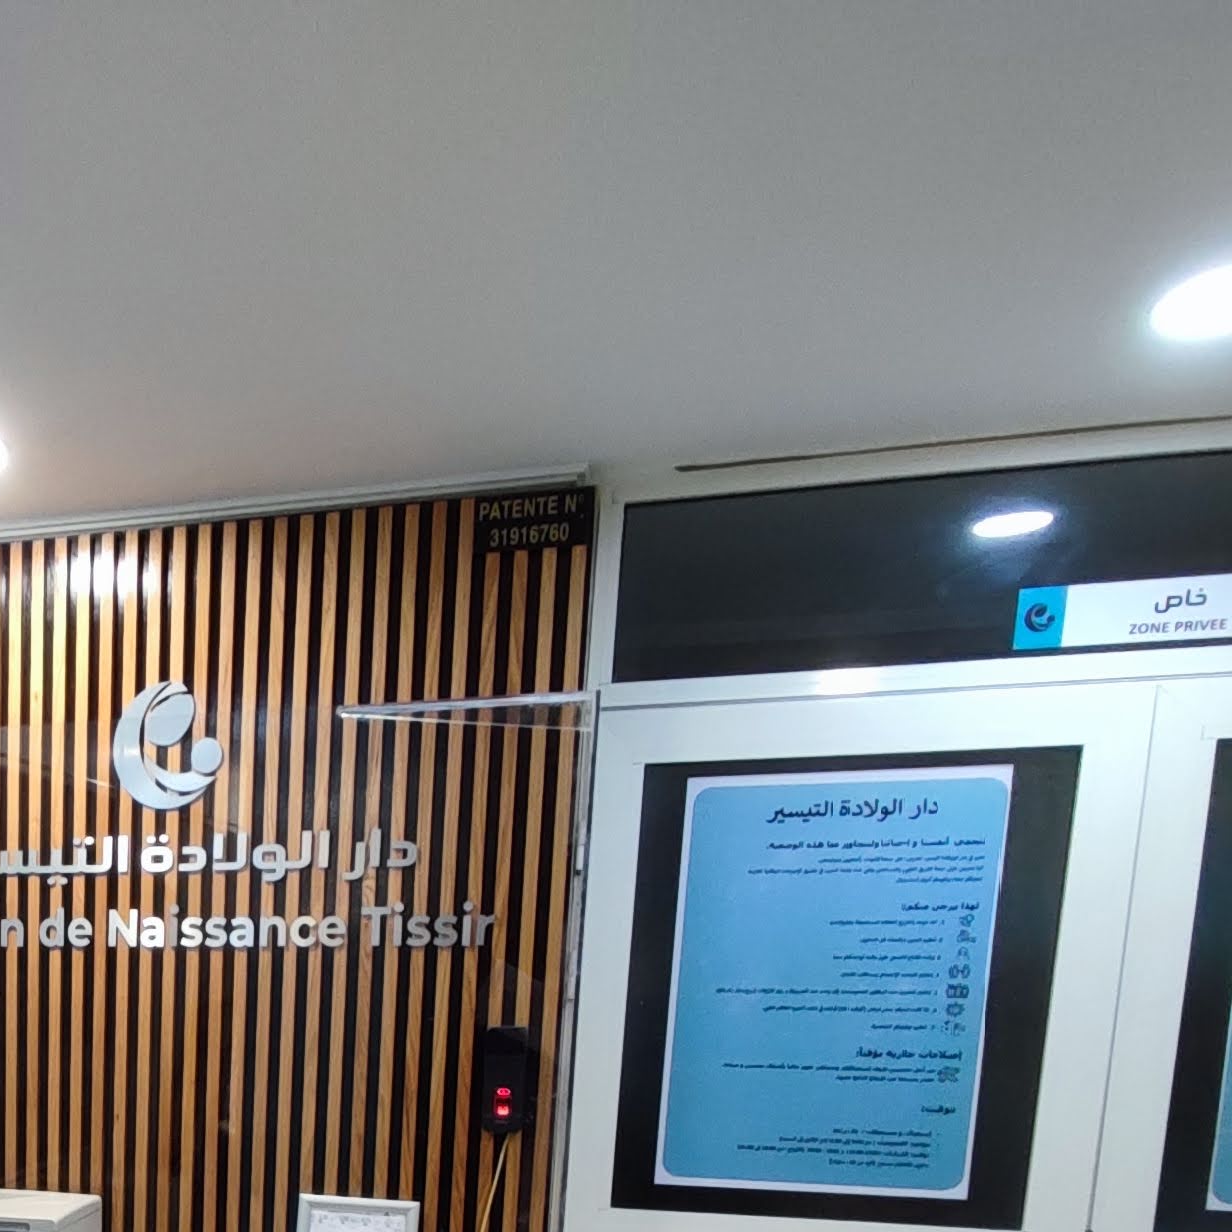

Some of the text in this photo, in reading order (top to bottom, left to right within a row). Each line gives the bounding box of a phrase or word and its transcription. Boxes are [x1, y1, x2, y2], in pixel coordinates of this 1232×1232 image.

[478, 495, 559, 521] PATENTE
[489, 523, 570, 547] 31916760
[1154, 587, 1208, 614] خاص
[1128, 618, 1228, 635] ZONE PRIVEE
[766, 797, 939, 824] دار الولادة التيسير
[140, 829, 331, 883] الولادة
[342, 827, 418, 881] دار
[39, 906, 93, 948] de
[107, 904, 347, 949] Naissance
[360, 900, 497, 948] Tissir
